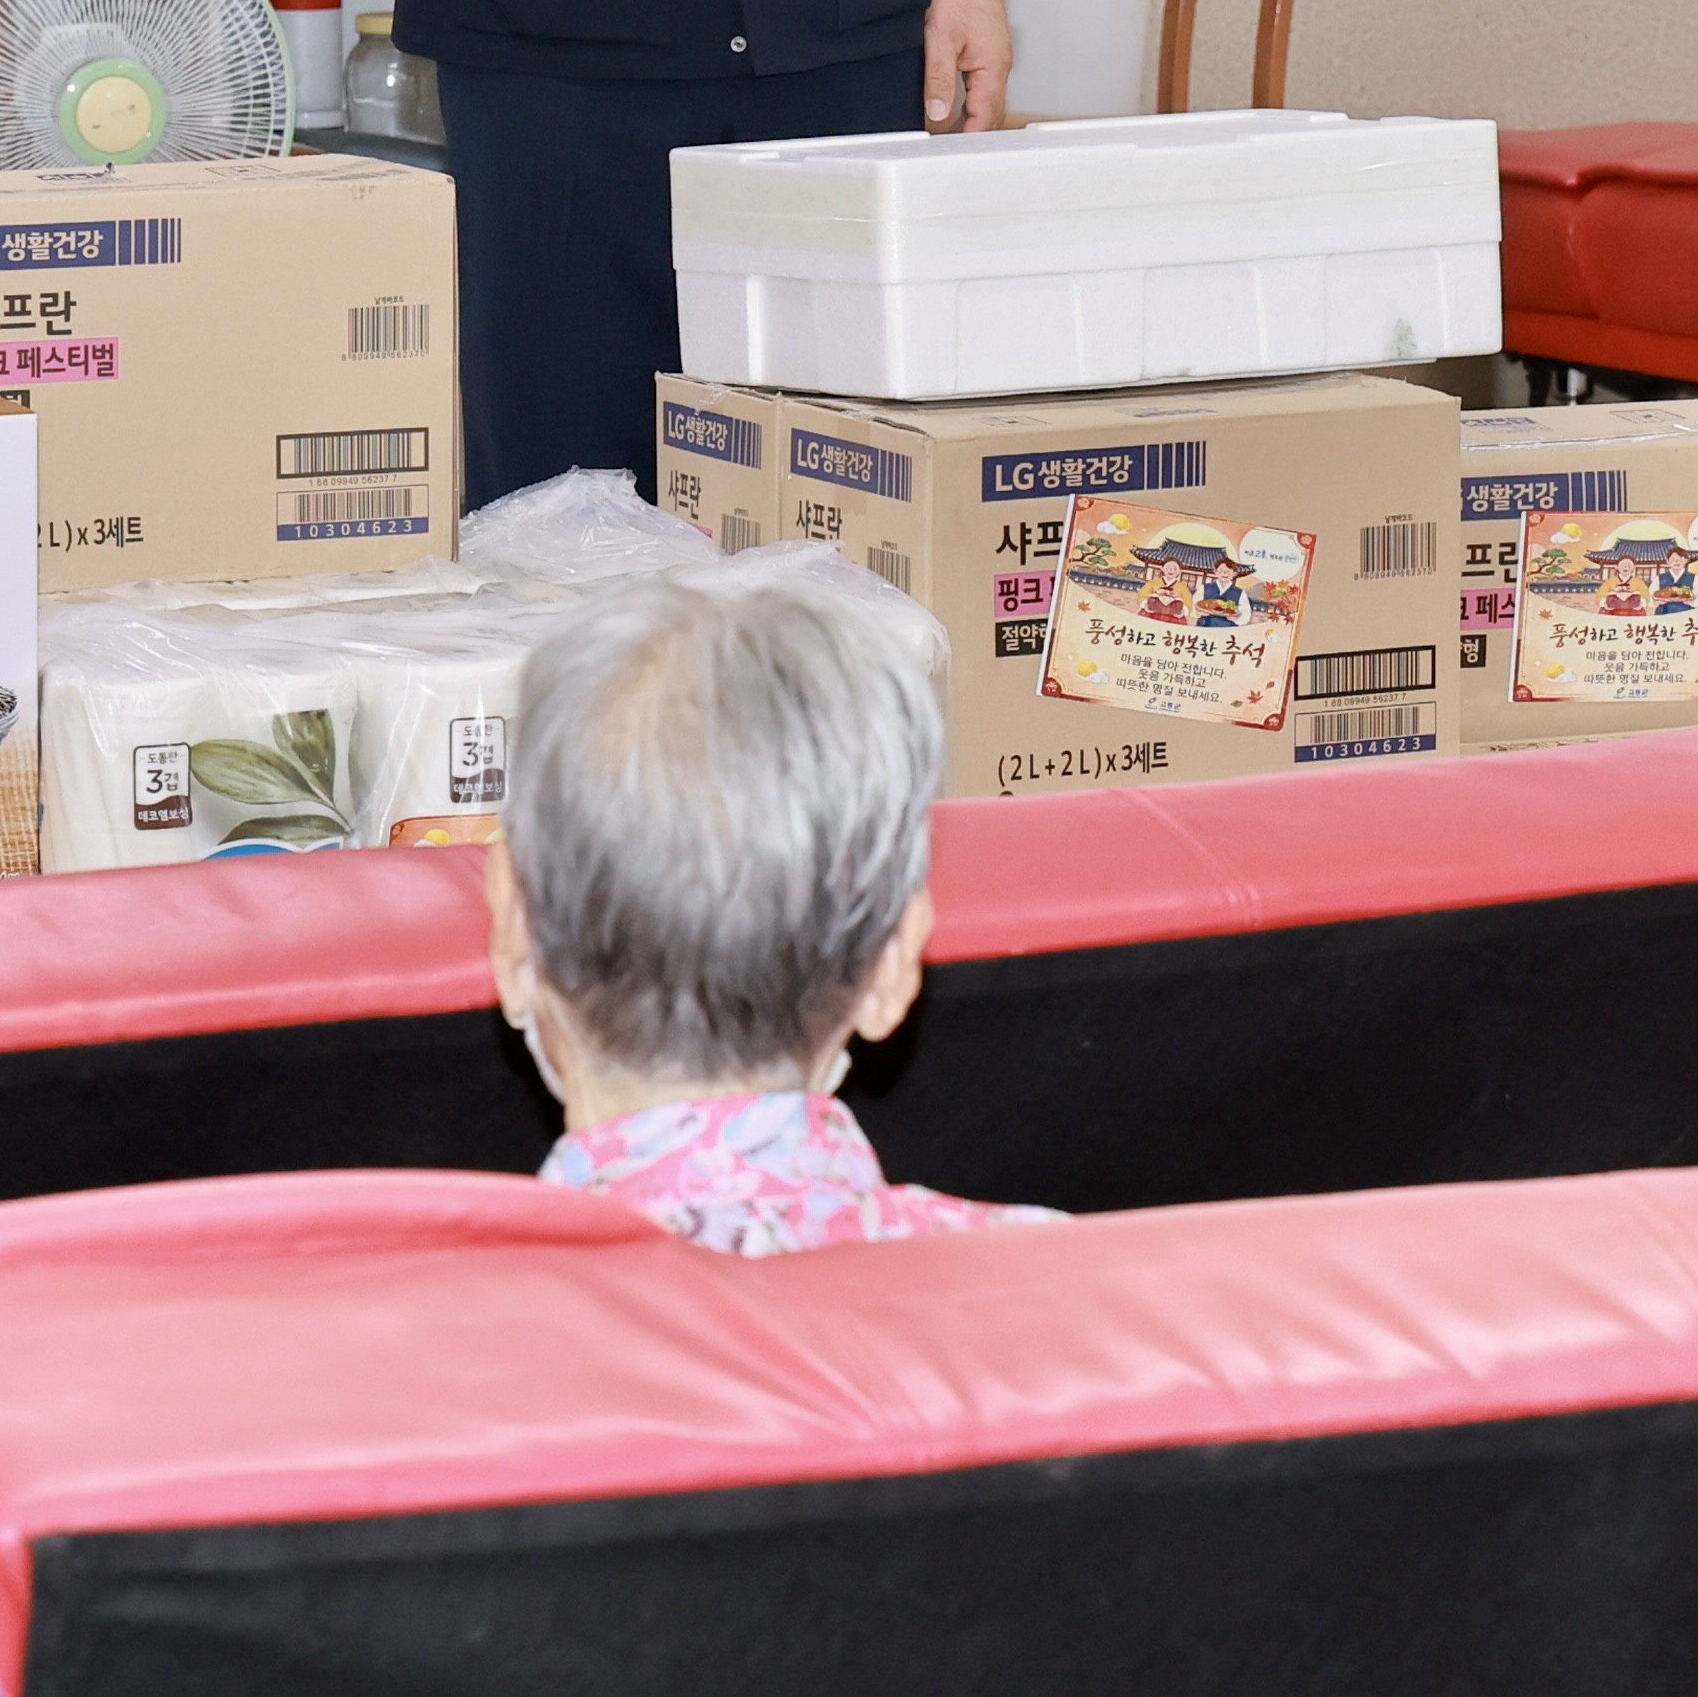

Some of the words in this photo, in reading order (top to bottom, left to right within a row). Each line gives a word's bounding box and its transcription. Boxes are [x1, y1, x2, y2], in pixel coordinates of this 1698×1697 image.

[2, 229, 104, 262] 생활건강
[17, 342, 115, 379] 페스티벌
[668, 411, 686, 440] LG
[797, 439, 819, 469] LG
[820, 444, 873, 482] 생활건강
[995, 464, 1034, 492] LG
[1037, 455, 1133, 487] 생활건강
[668, 470, 701, 520] 샤프란
[1466, 481, 1558, 512] 생활건강
[996, 520, 1064, 566] 샤프
[998, 577, 1044, 612] 핑크
[1085, 619, 1156, 645] 풍성하고
[1162, 630, 1217, 658] 행복한
[1221, 635, 1265, 668] 추석
[1550, 623, 1618, 648] 풍성하고
[1624, 623, 1676, 645] 행복한
[1120, 653, 1153, 666] 마음을
[1157, 658, 1178, 670] 담아
[1182, 662, 1227, 679] 전합니다.
[1586, 651, 1617, 660] 마음을
[1621, 651, 1641, 660] 담아
[1645, 650, 1689, 660] 전합니다.
[1629, 662, 1669, 672] 가득하고
[1116, 678, 1149, 691] 따뜻한
[1177, 688, 1223, 704] 보내세요.
[1163, 673, 1206, 688] 가득하고
[1584, 674, 1616, 684] 따뜻한
[1643, 673, 1688, 683] 보내세요.
